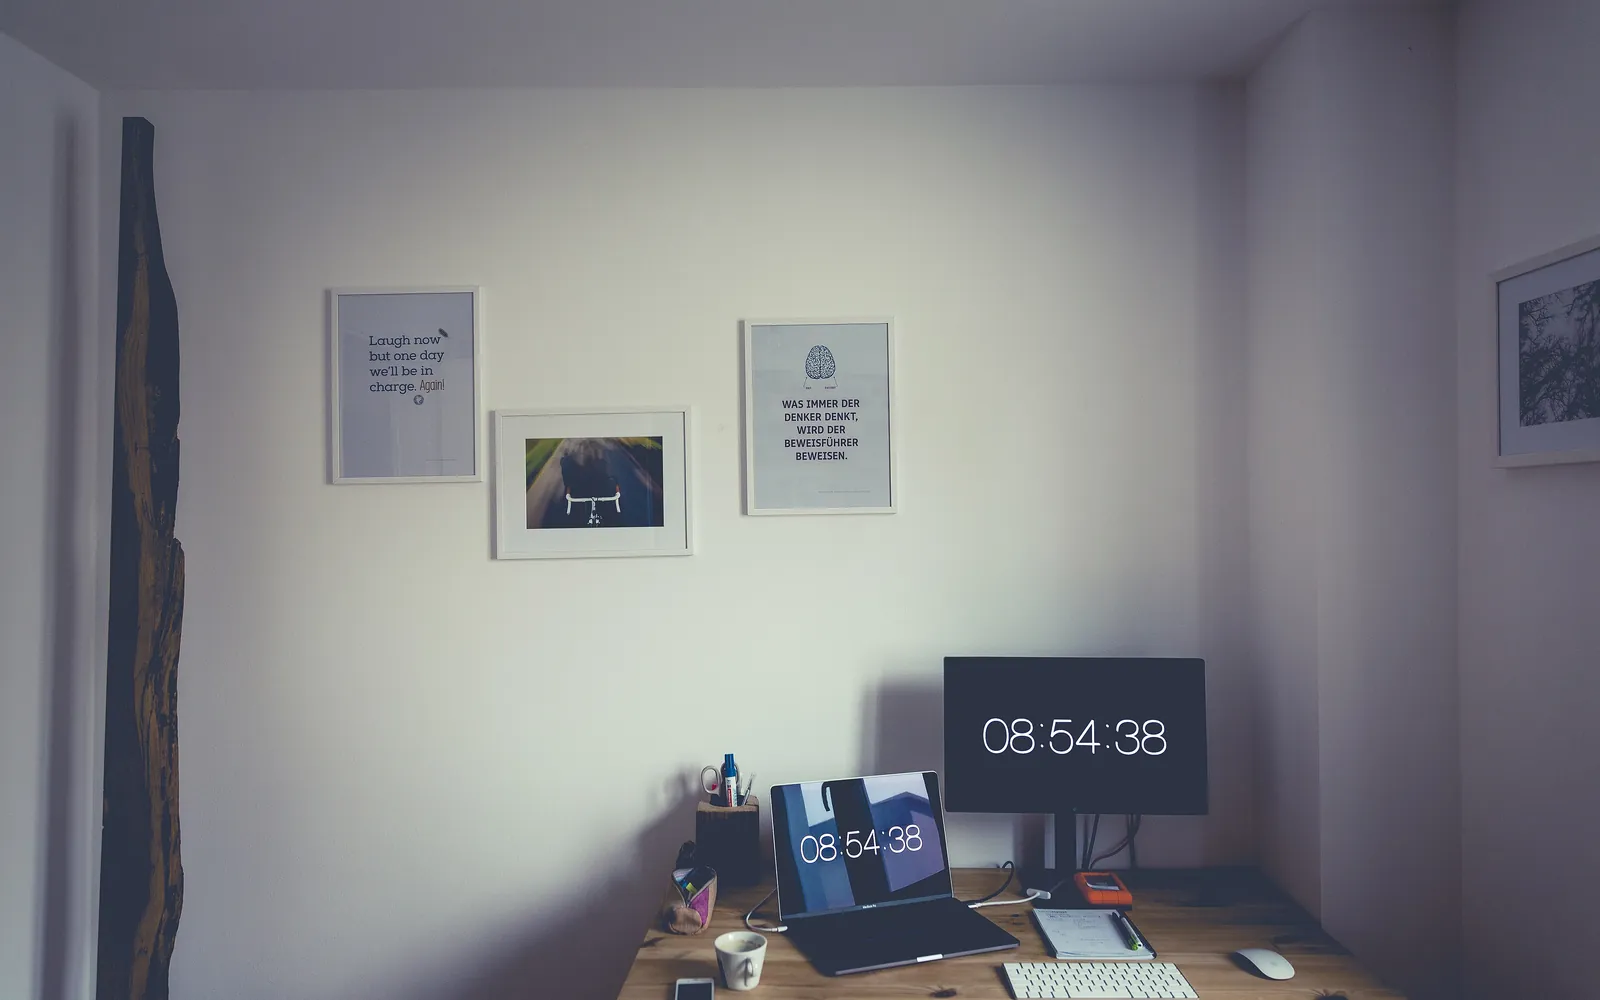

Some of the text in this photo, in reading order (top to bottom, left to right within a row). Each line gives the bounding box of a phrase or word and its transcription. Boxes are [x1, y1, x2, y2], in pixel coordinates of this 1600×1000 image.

[369, 335, 441, 348] Laugh now
[369, 350, 444, 363] but one day
[401, 366, 418, 376] be
[420, 366, 434, 376] in
[369, 379, 445, 395] charge. Again!
[782, 399, 860, 409] WAS IMMER DER
[784, 412, 858, 422] DENKER DENKT,
[796, 425, 846, 435] WIRD DER
[784, 436, 859, 448] BEWEISFÜHRER
[795, 451, 848, 461] BEWEISEN.
[982, 717, 1168, 756] 08:54:38
[800, 824, 924, 864] 08:54:38
